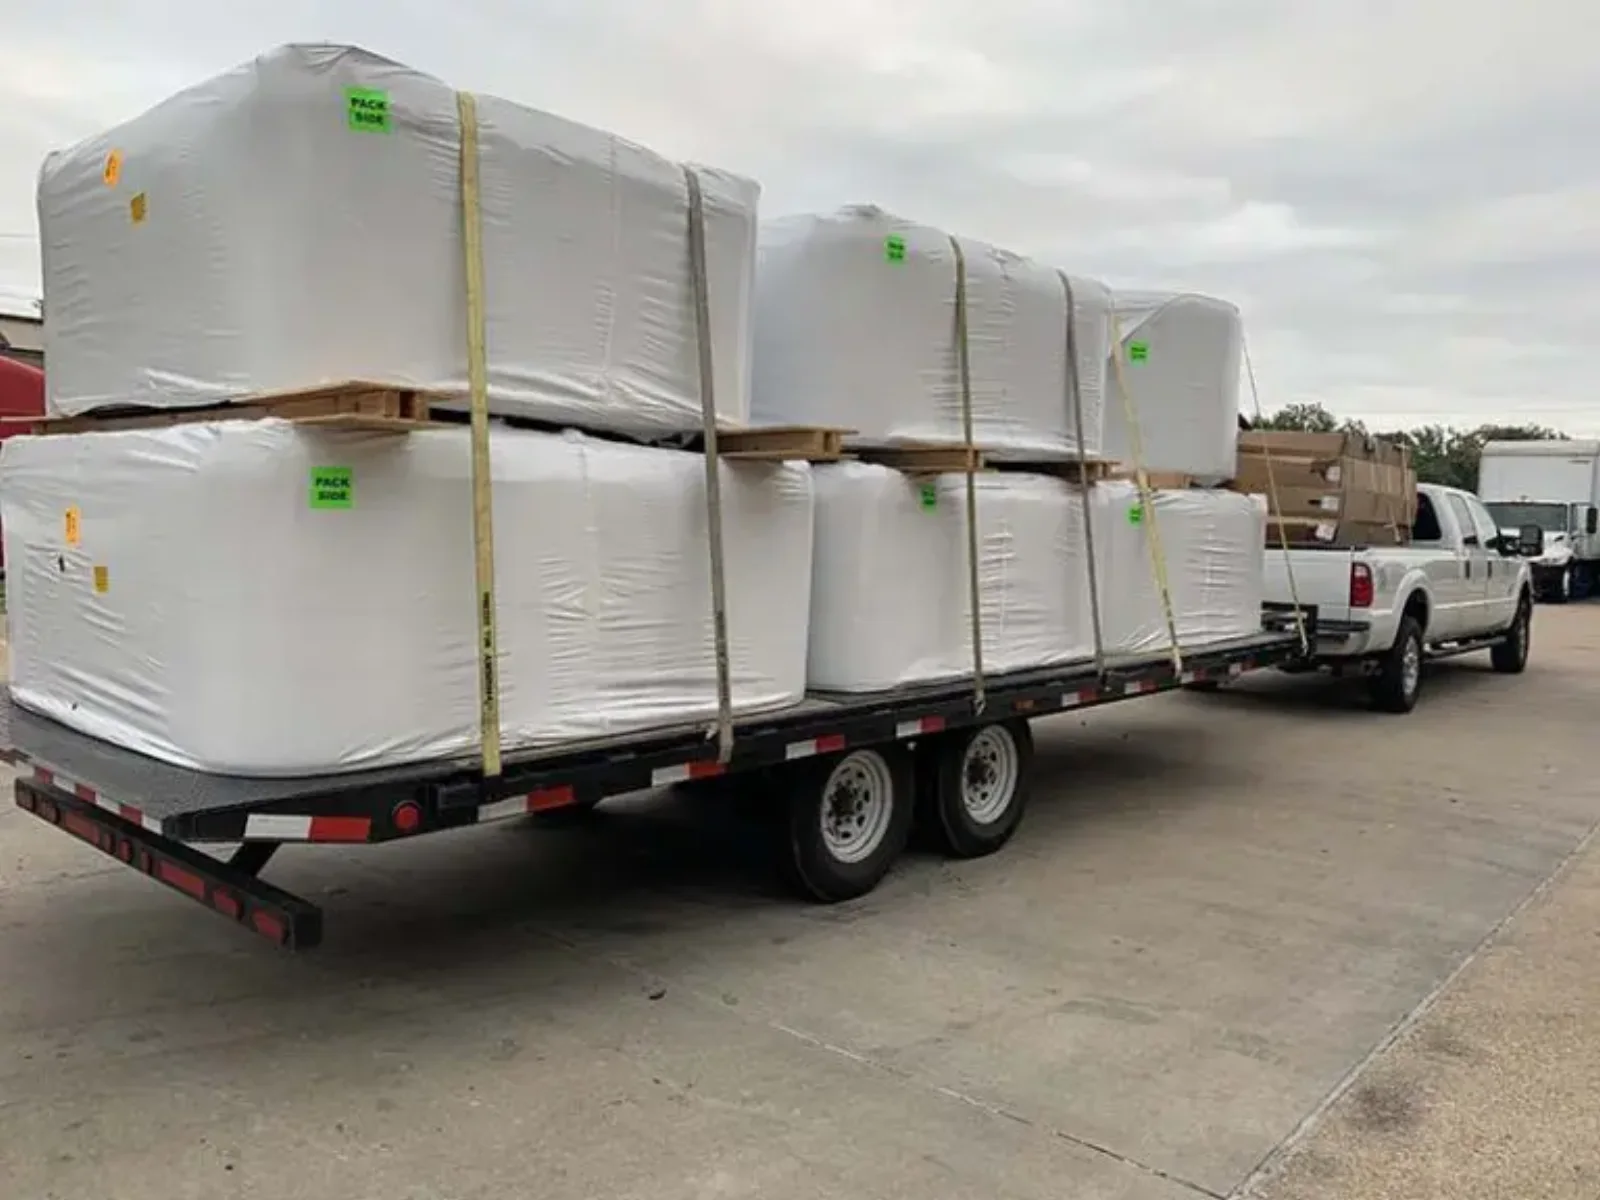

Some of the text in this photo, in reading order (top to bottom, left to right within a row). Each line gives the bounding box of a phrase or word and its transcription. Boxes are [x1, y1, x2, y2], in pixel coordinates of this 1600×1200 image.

[350, 97, 386, 110] PACK
[355, 111, 384, 125] SIDE
[315, 477, 350, 489] PACK
[317, 491, 348, 501] SIDE
